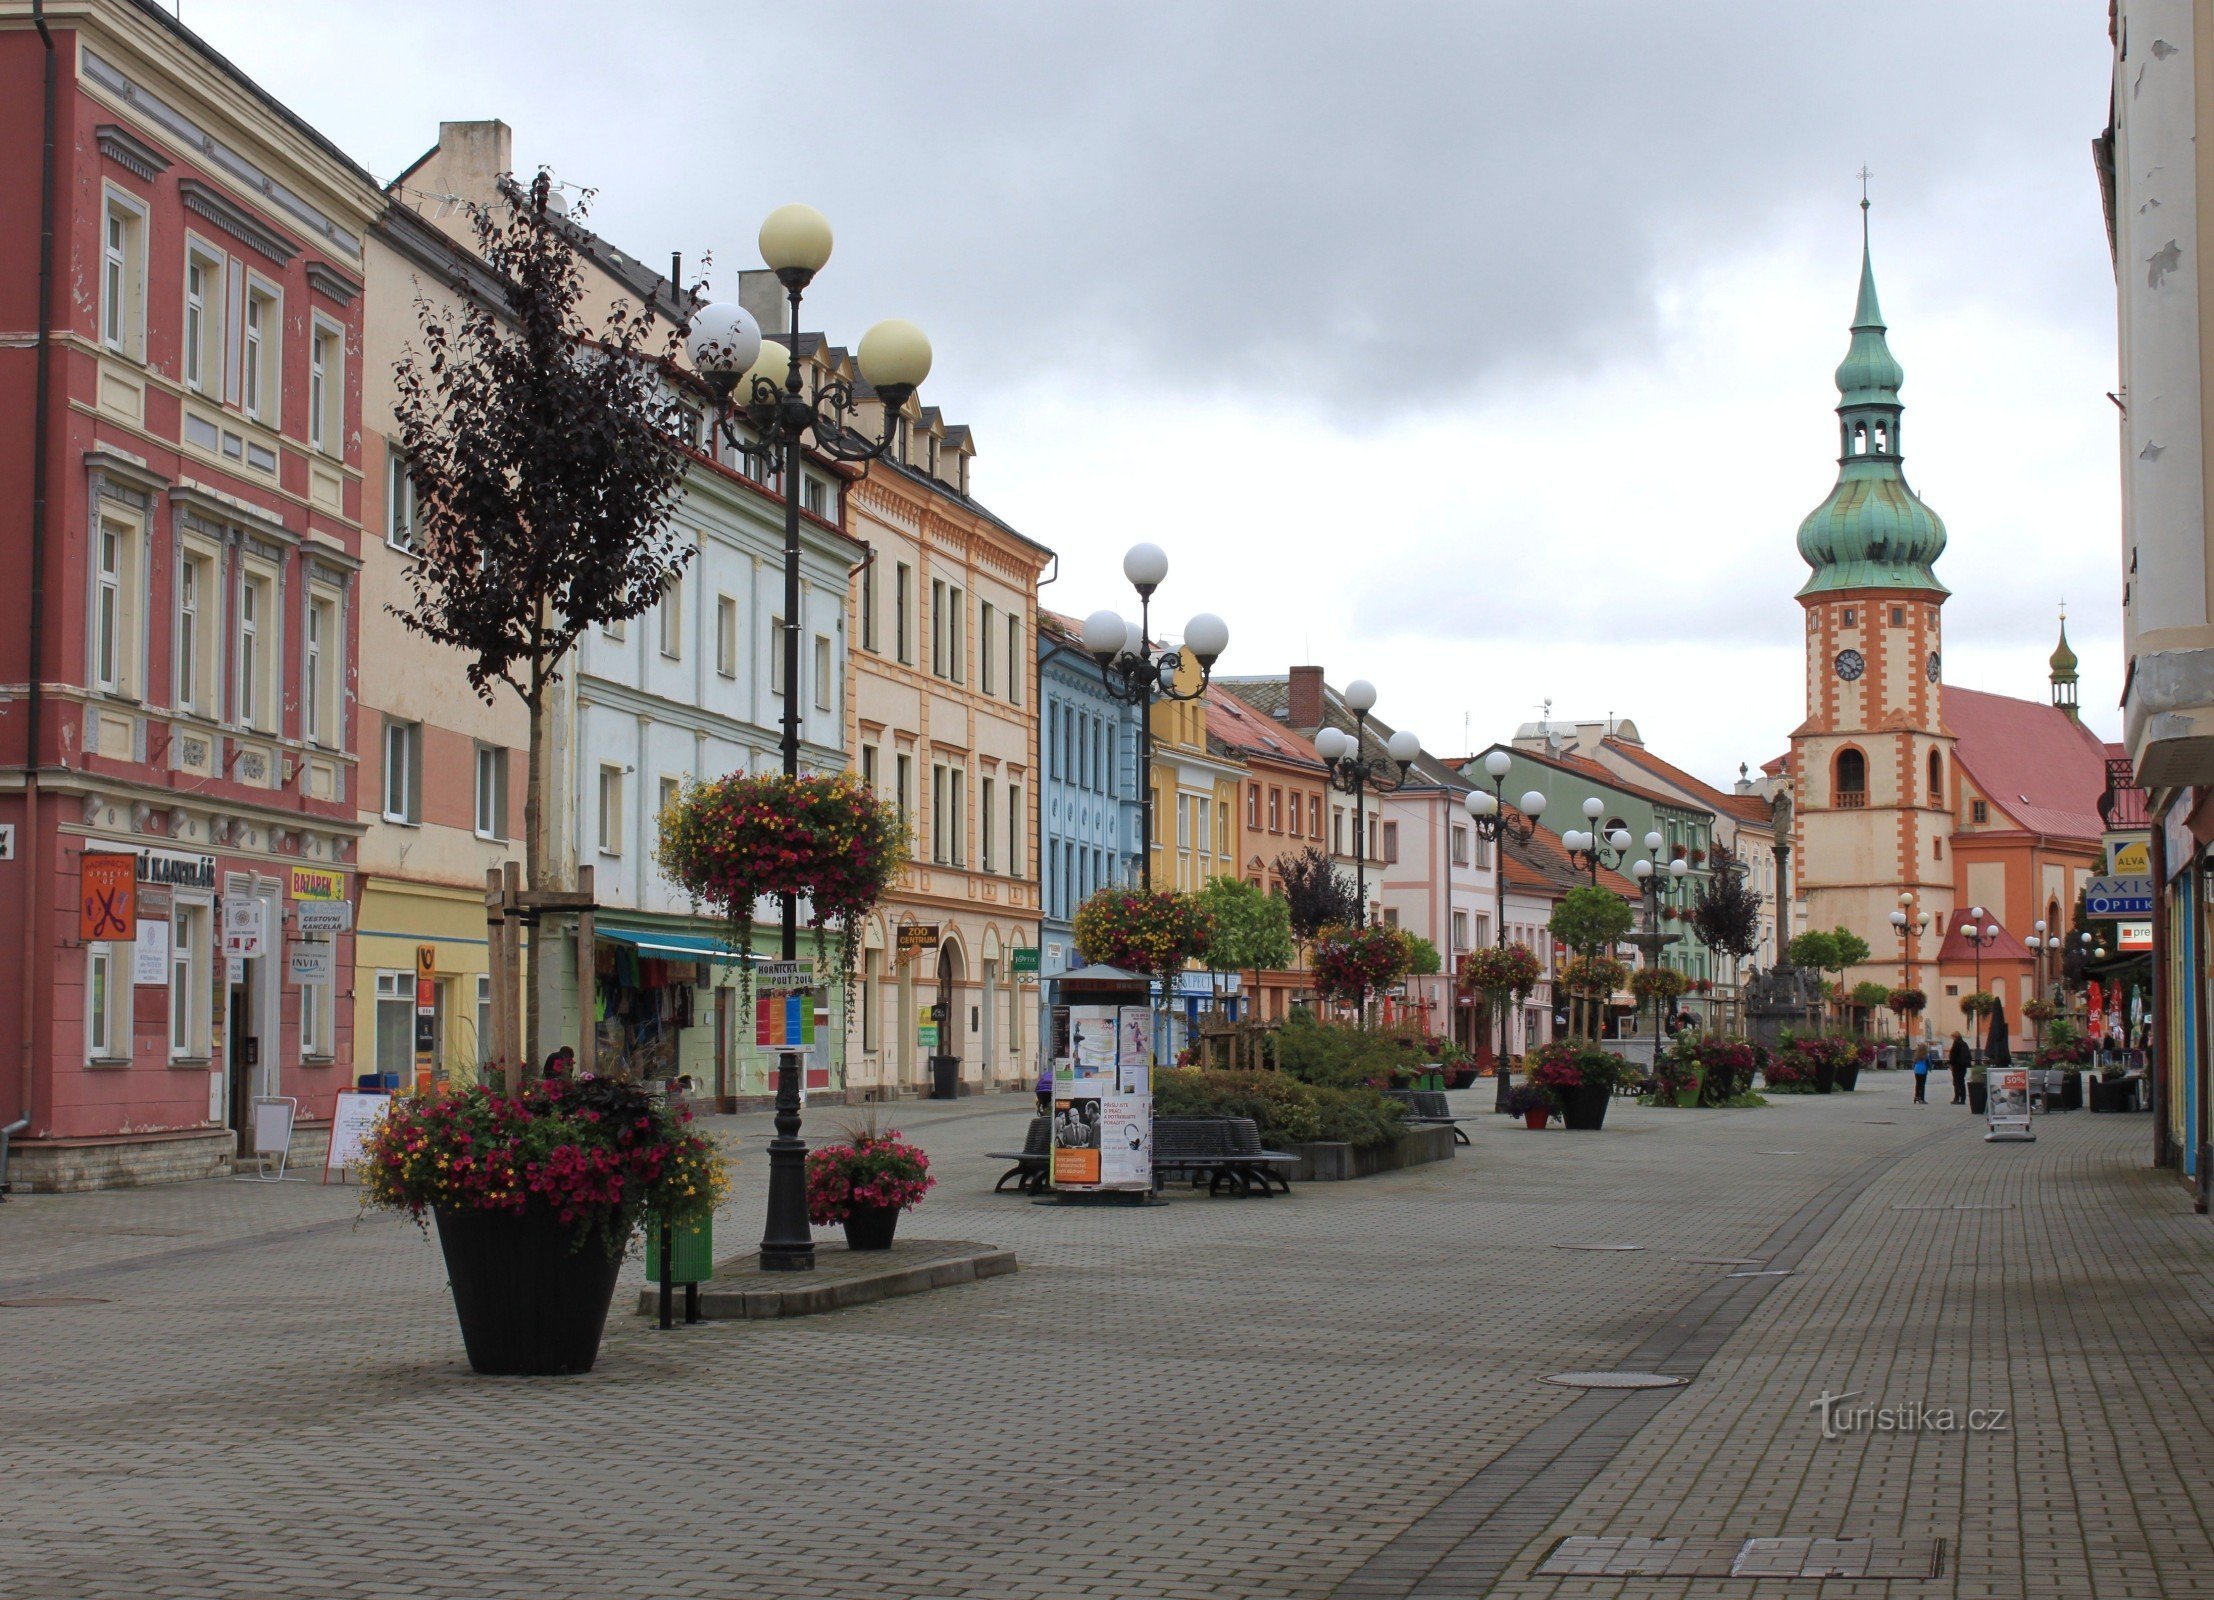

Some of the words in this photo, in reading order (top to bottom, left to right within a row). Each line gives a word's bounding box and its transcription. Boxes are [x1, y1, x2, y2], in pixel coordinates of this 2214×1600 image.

[2117, 857, 2145, 866] ALVA
[151, 856, 215, 888] KANCELÁŘ
[294, 872, 331, 896] BAZÁREK
[908, 928, 928, 936] ZOO
[899, 936, 937, 944] CENTRUM
[292, 958, 319, 967] INVIA
[795, 975, 813, 984] 2014
[2006, 1076, 2026, 1085] 50%
